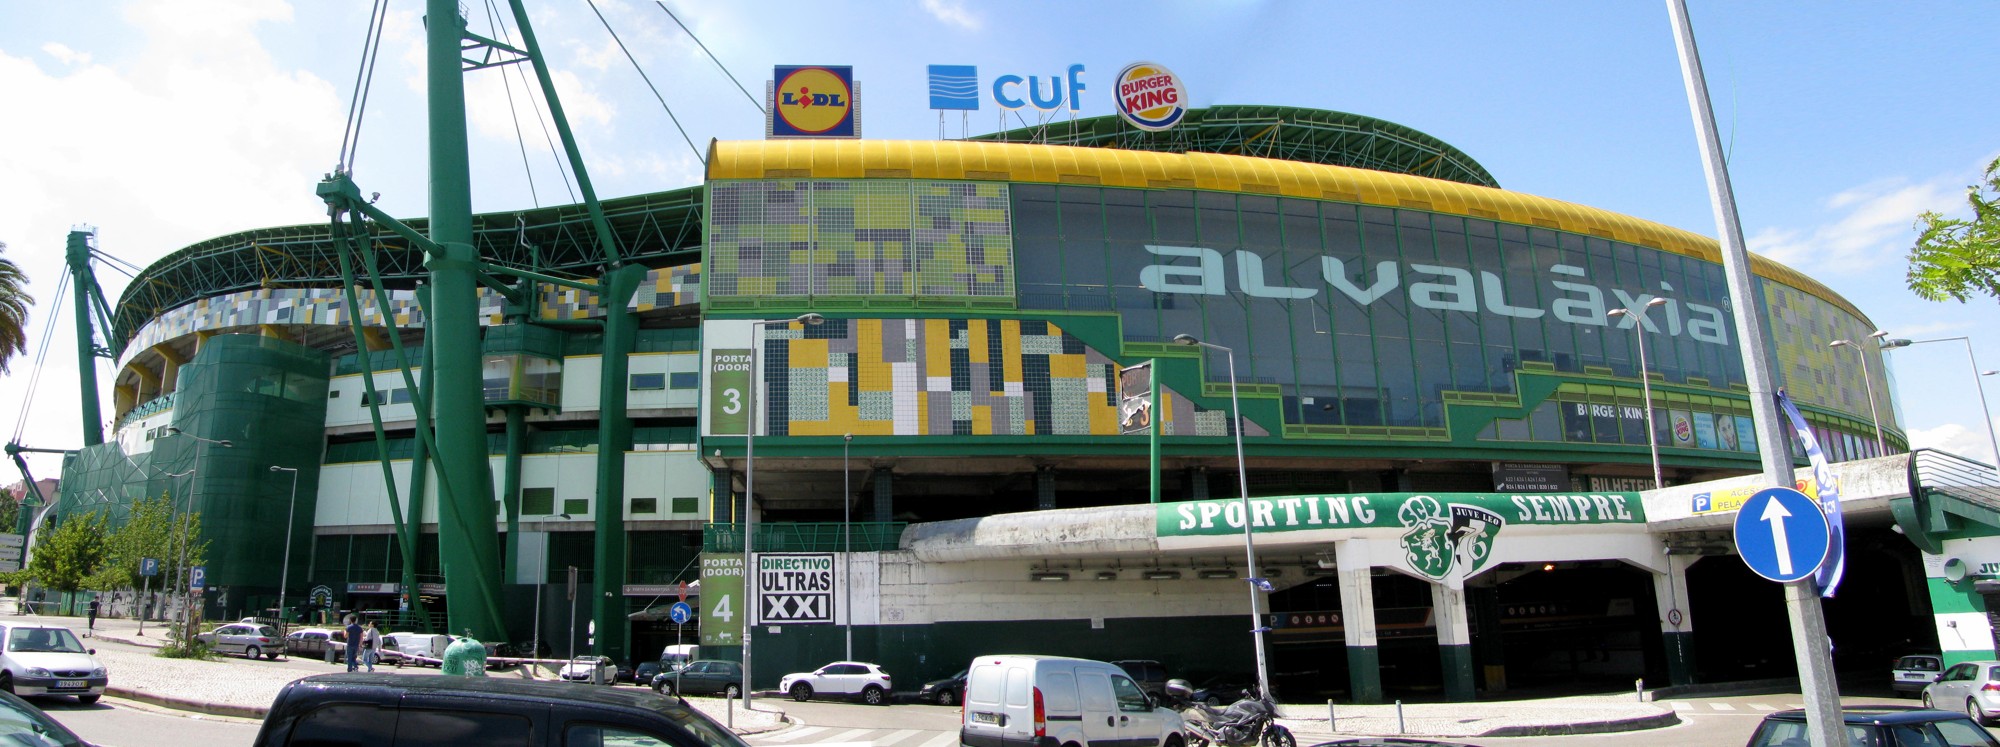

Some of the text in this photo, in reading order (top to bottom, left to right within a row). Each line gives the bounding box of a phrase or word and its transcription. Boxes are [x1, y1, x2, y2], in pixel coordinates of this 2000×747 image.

[993, 64, 1085, 111] cuf
[1121, 74, 1172, 97] BURGER
[1125, 87, 1178, 114] KING
[715, 355, 752, 363] PORTA
[713, 364, 750, 372] (DOOR
[722, 388, 741, 415] 3
[1177, 495, 1632, 529] SPORTING SEMPRE
[1696, 498, 1707, 512] P
[1717, 500, 1741, 510] PELA
[1456, 508, 1499, 526] JUVE LEO
[146, 561, 154, 571] P
[703, 558, 742, 567] PORTA
[761, 558, 830, 570] DIRECTIVO
[193, 568, 204, 585] P
[702, 567, 745, 578] (DOOR)
[762, 572, 830, 591] ULTRAS
[712, 594, 734, 623] 4
[766, 595, 827, 618] XXI
